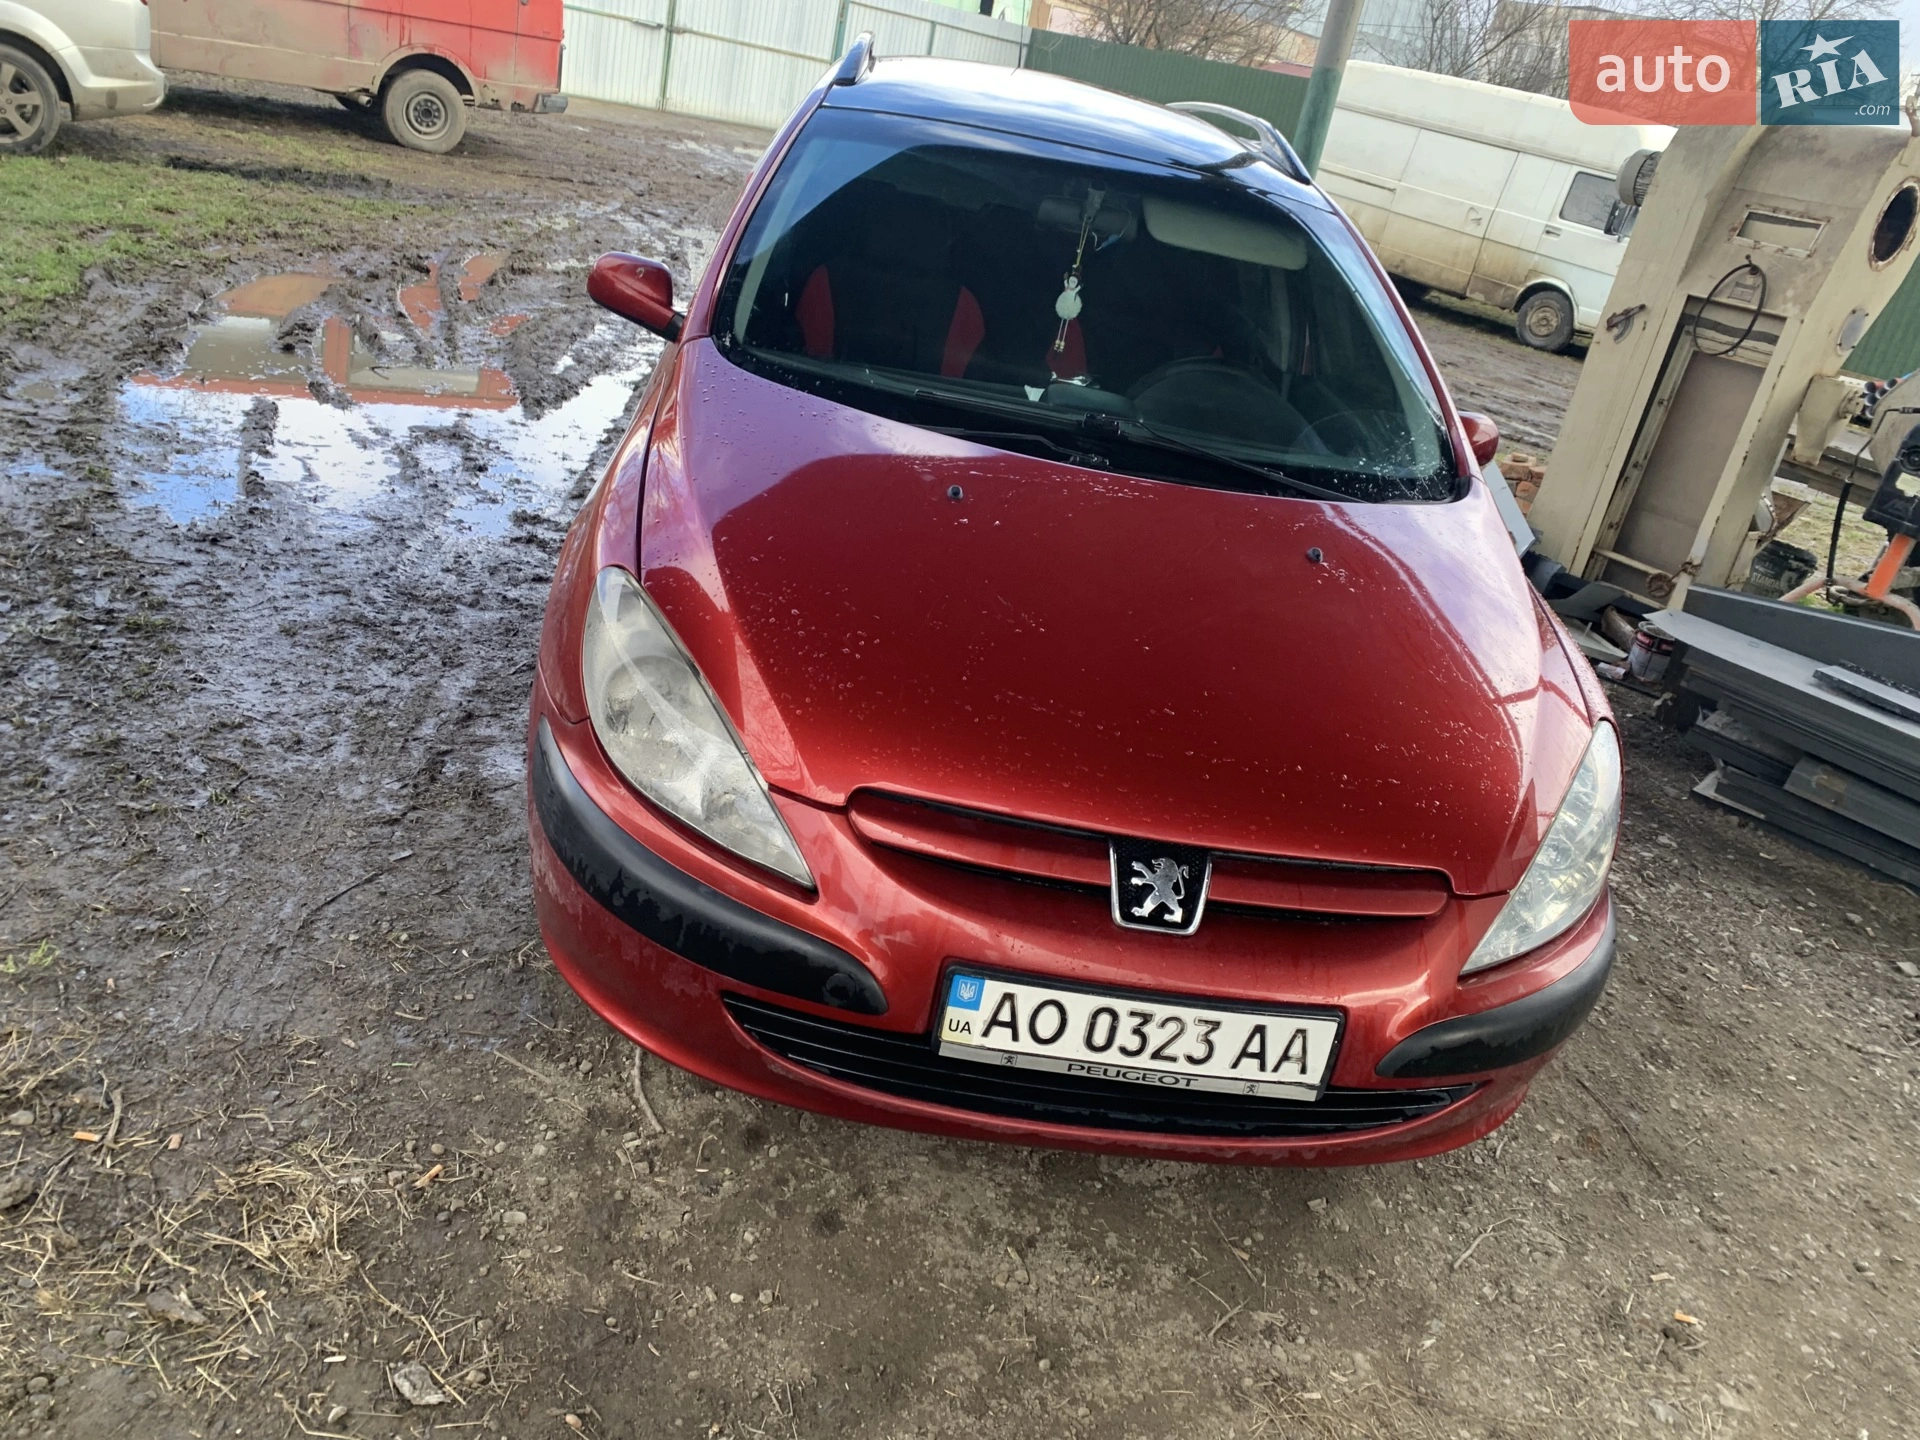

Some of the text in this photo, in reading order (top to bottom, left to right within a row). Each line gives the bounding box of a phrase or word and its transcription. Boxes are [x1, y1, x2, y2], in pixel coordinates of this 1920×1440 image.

[947, 1018, 972, 1036] UA
[981, 992, 1309, 1075] AO 0323 AA
[1066, 1063, 1199, 1088] PEUGEOT
